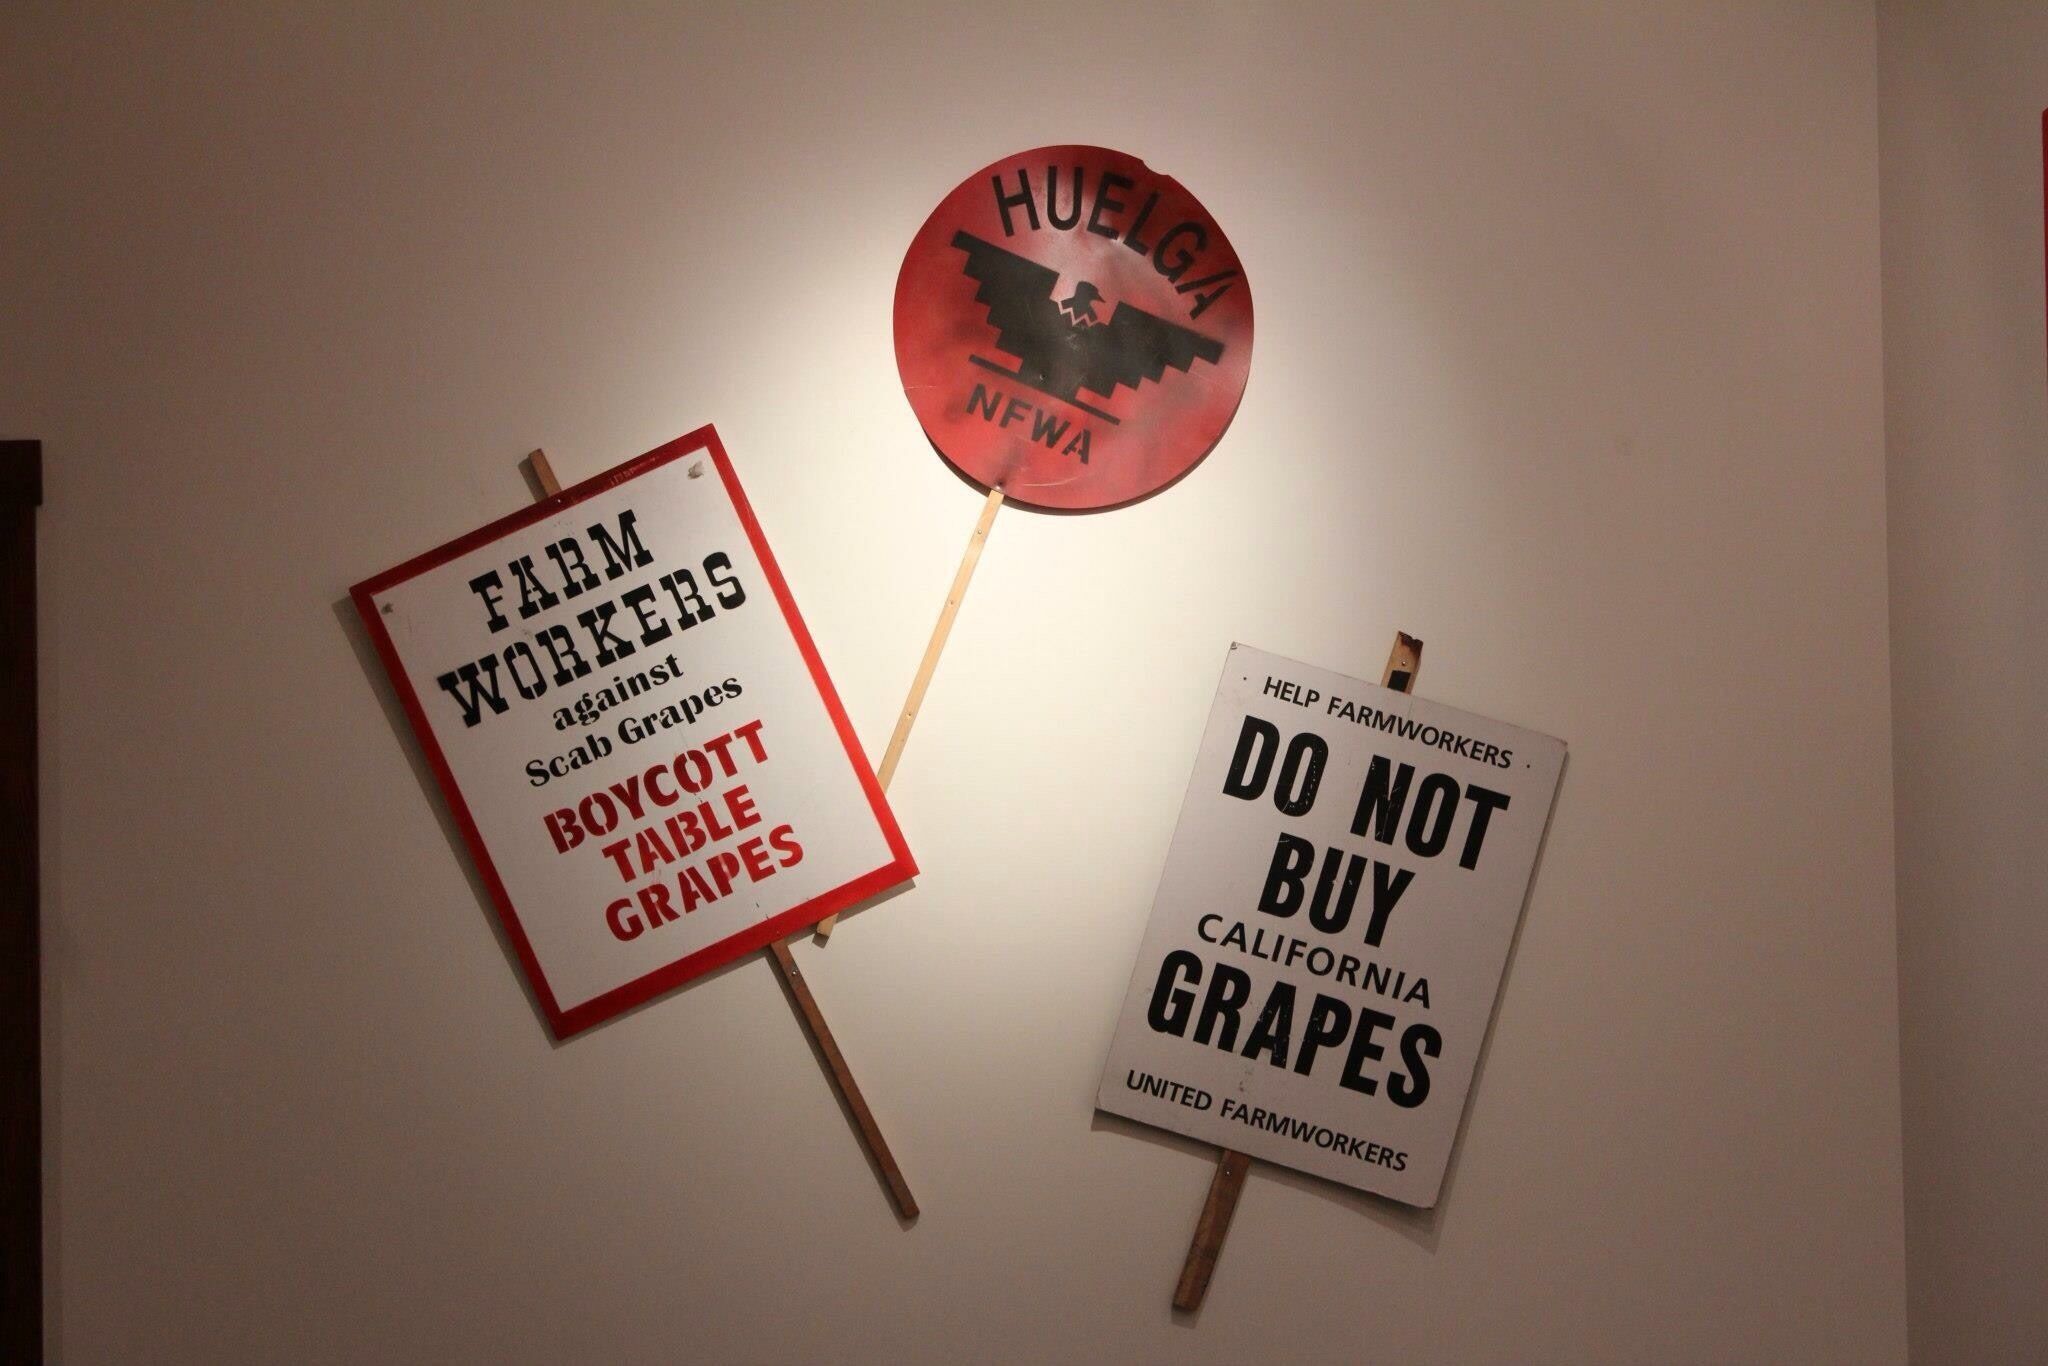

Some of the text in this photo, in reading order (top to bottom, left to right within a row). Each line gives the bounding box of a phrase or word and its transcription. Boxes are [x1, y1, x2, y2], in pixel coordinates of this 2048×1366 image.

[992, 166, 1237, 319] HUELGA
[965, 384, 1092, 465] NFWA
[469, 509, 654, 633] FARM
[437, 551, 746, 728] WORKERS
[553, 653, 684, 732] against
[525, 676, 744, 787] Scab Grapes
[1263, 676, 1513, 769] HELP FARMWORKERS
[543, 719, 769, 854] BOYCOTT
[602, 785, 762, 884] TABLE
[1222, 715, 1511, 871] DO NOT
[605, 824, 804, 942] GRAPES
[1257, 832, 1416, 948] BUY
[1198, 914, 1431, 1009] CALIFORNIA
[1147, 949, 1443, 1109] GRAPES
[1126, 1069, 1409, 1172] UNITED FARMWORKERS
